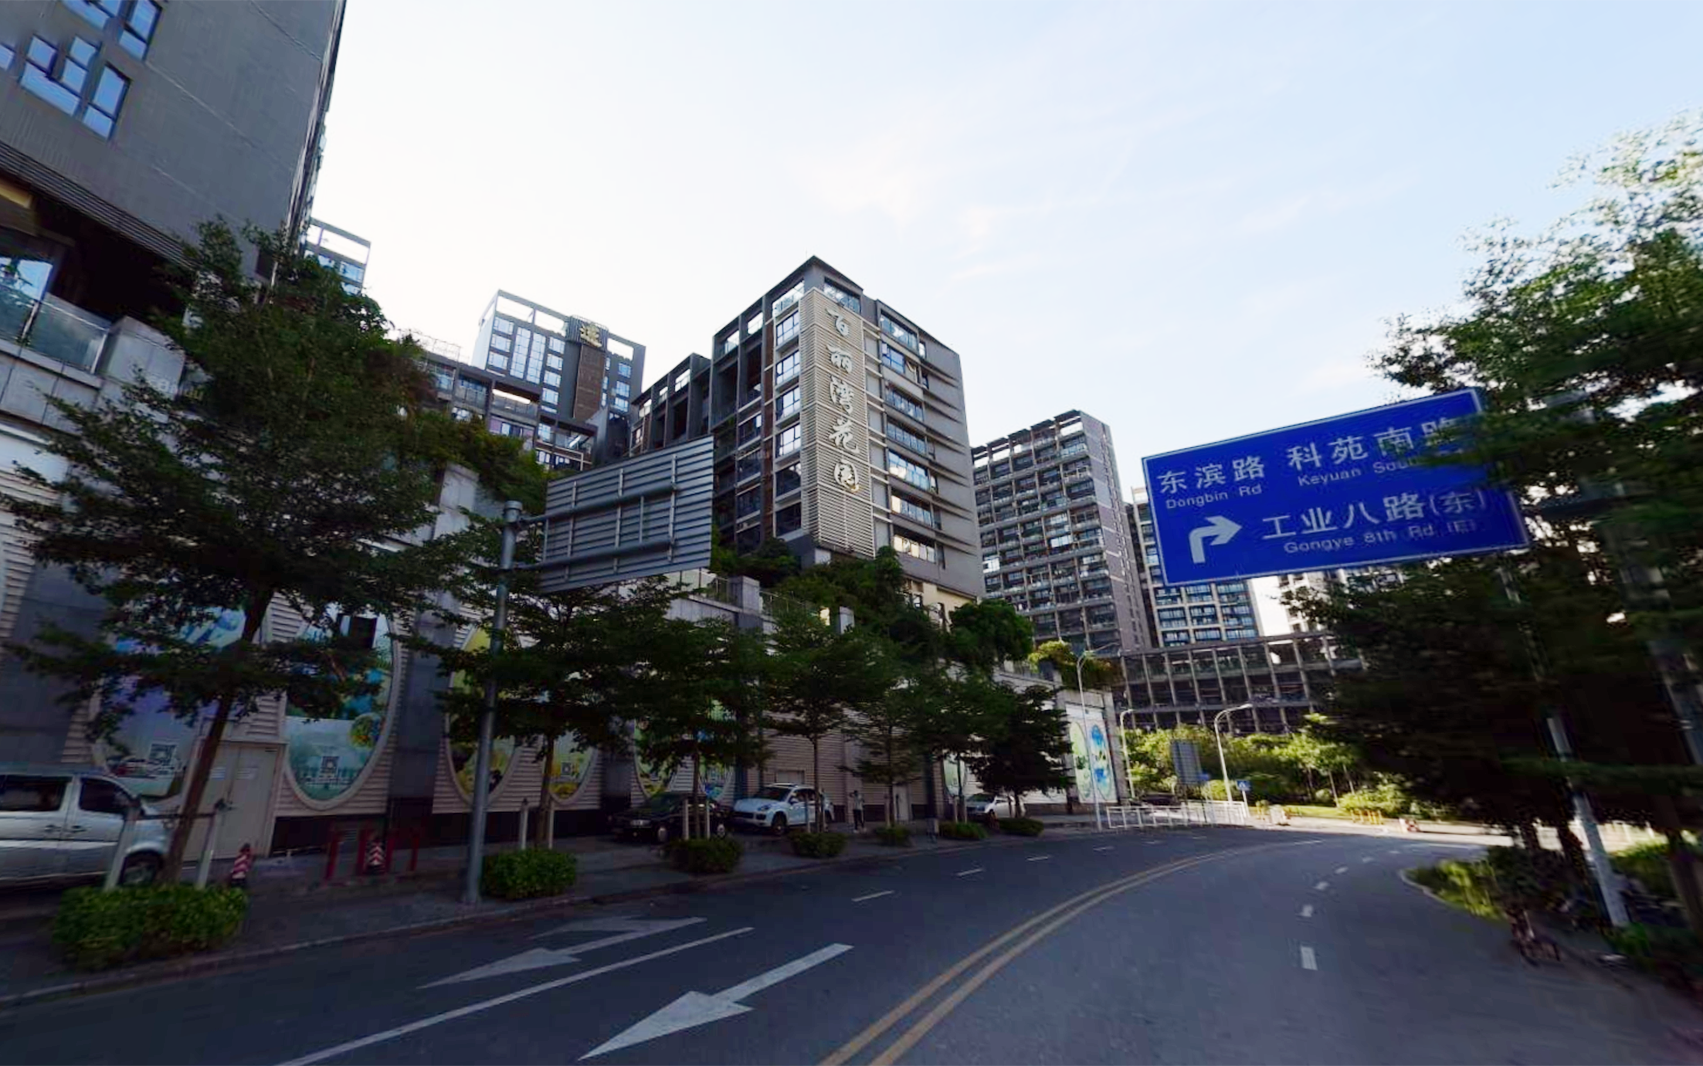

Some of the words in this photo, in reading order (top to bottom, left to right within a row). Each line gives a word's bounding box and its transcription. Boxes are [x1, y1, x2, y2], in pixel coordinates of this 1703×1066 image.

[1157, 455, 1265, 494] 东滨路
[1166, 491, 1229, 509] Dongbin
[1238, 483, 1263, 498] Rd
[1297, 467, 1362, 487] Keyuan
[1373, 456, 1422, 474] Sou
[1283, 536, 1355, 554] Gongye
[1364, 529, 1397, 544] 8th
[1408, 523, 1435, 539] Rd
